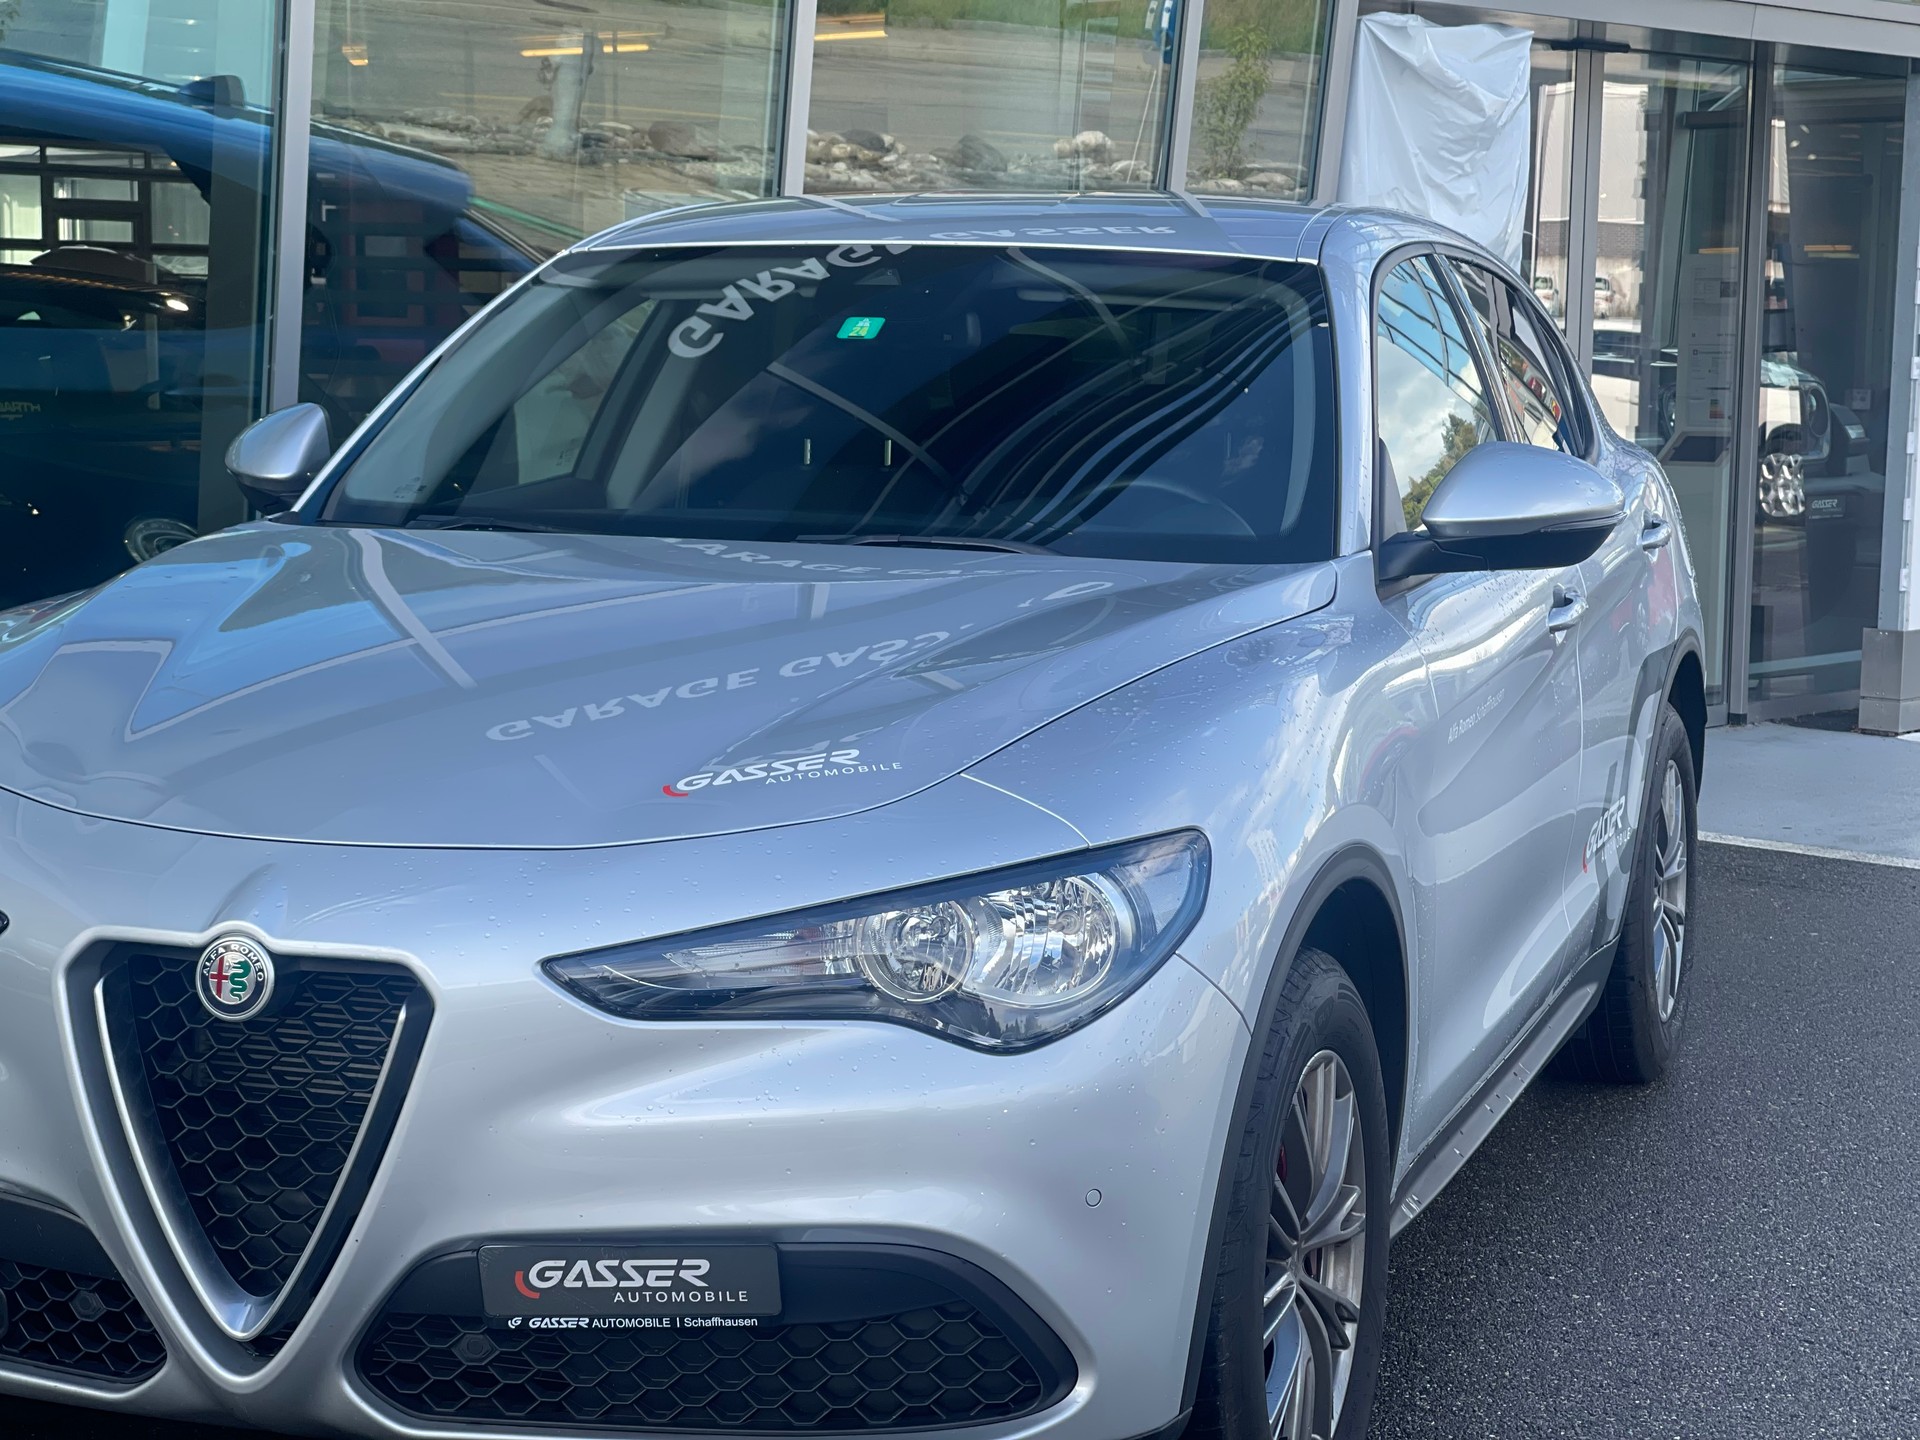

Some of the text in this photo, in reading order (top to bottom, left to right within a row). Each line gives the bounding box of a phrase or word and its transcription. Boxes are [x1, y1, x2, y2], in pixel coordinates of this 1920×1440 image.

[675, 749, 860, 791] GASSER
[765, 762, 903, 784] AUTOMOBILE
[203, 943, 264, 982] ALFA ROMEO
[528, 1259, 711, 1289] GASSER
[613, 1291, 749, 1303] AUTOMOBILE
[529, 1317, 589, 1329] GASSER
[592, 1317, 671, 1328] AUTOMOBILE
[684, 1316, 758, 1328] Schaffhausen
